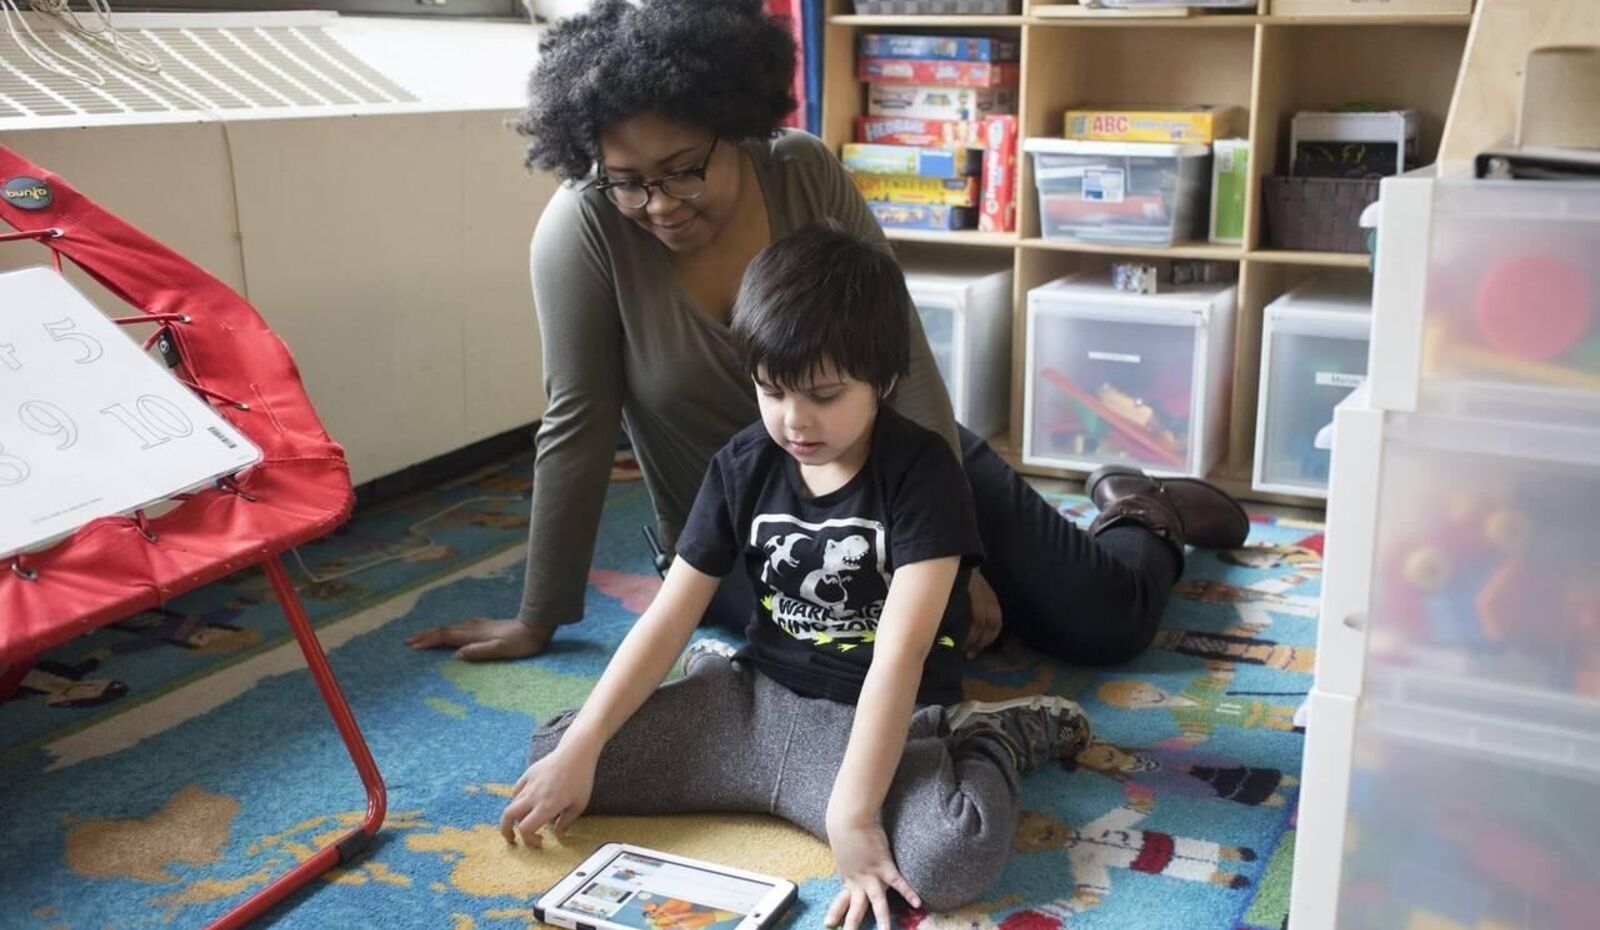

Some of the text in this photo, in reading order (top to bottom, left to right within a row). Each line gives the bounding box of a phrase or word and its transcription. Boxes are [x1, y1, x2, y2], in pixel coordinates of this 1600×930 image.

[1092, 116, 1128, 132] ABC
[42, 317, 103, 364] 5
[18, 394, 193, 450] 9 10
[831, 620, 878, 633] ZON
